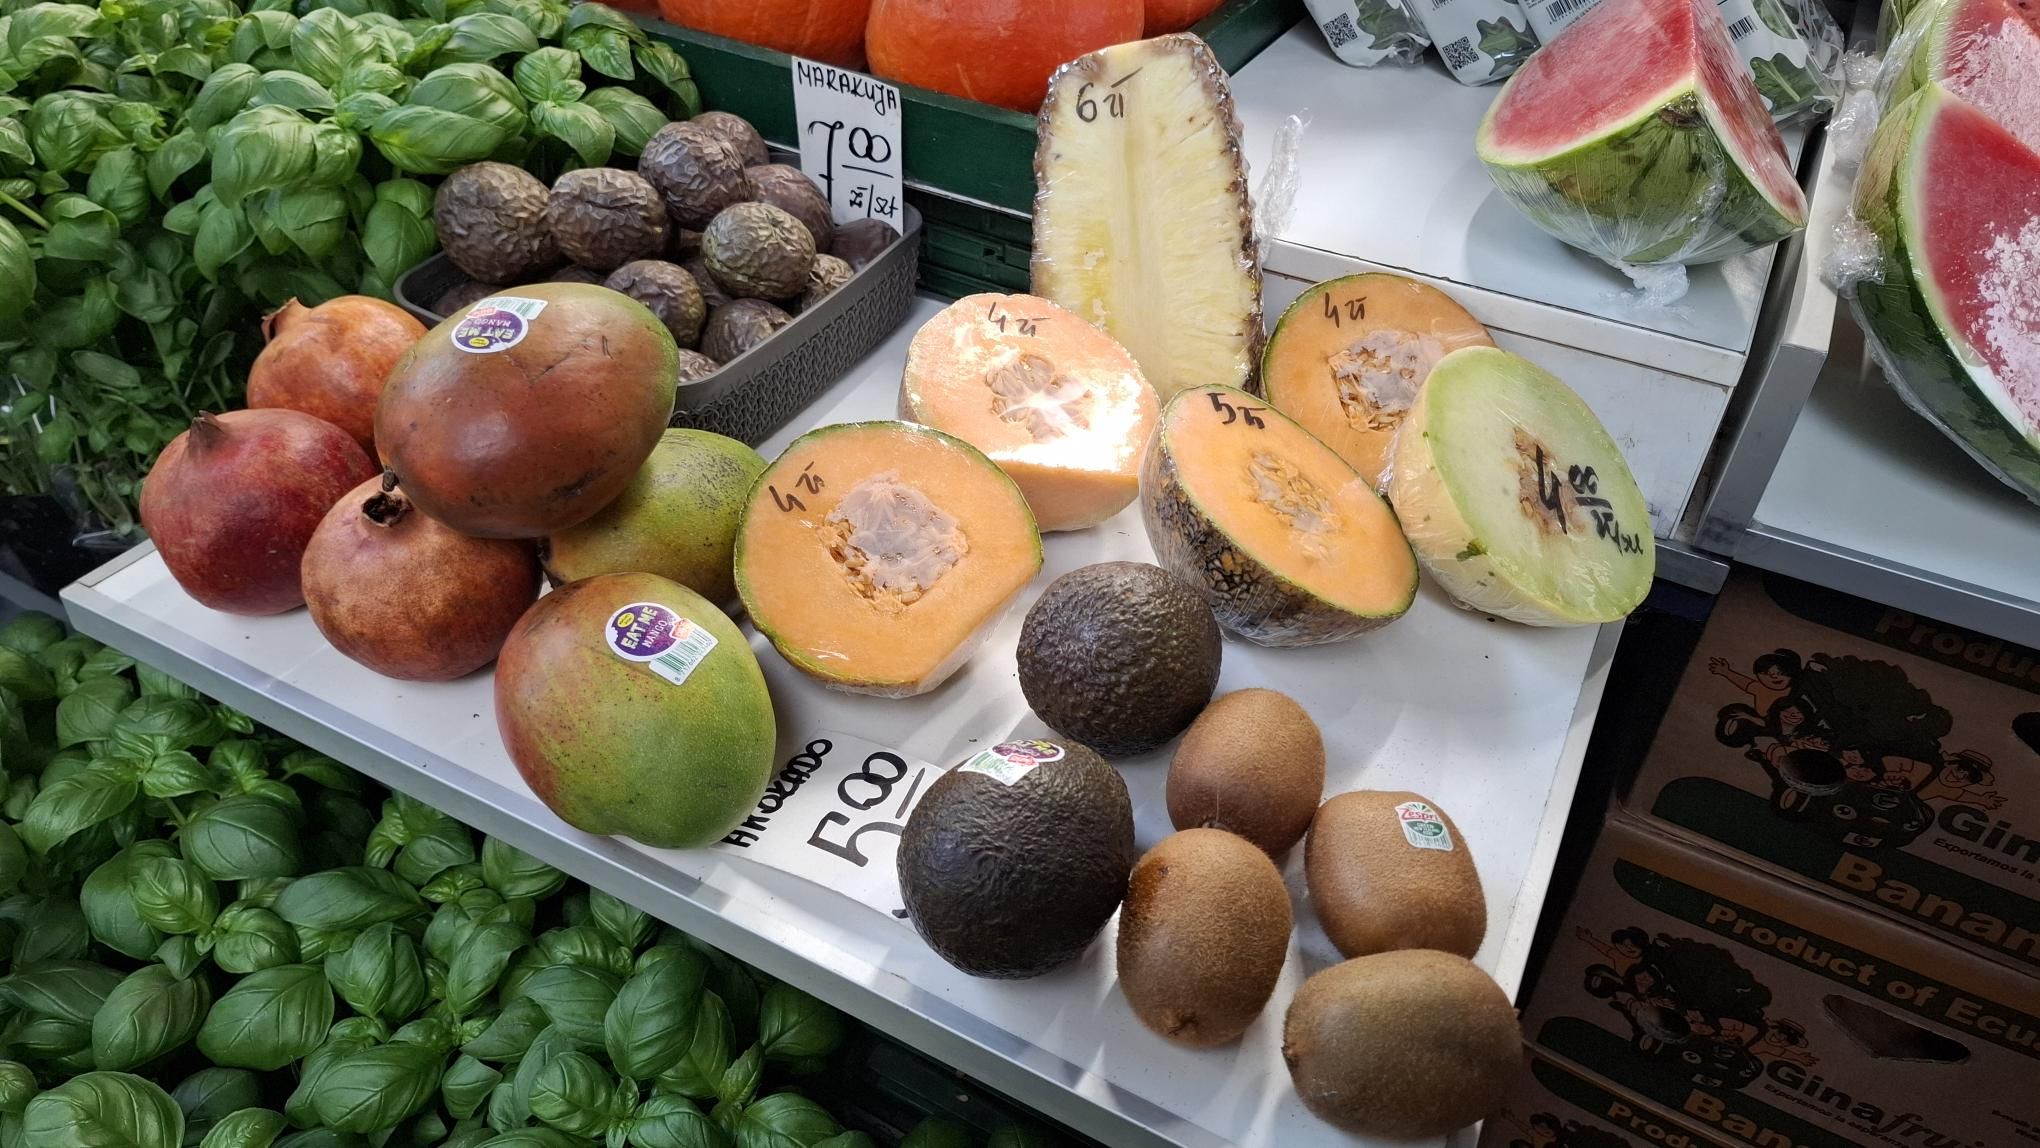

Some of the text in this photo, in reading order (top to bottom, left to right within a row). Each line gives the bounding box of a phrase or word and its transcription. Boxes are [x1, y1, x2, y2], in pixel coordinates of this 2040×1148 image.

[797, 61, 897, 116] MARAKUJA
[1076, 82, 1098, 123] 6
[987, 302, 1007, 333] 4
[1324, 292, 1340, 329] 4
[481, 327, 516, 340] EAT
[1207, 392, 1237, 425] 5
[768, 485, 807, 513] 4
[620, 622, 647, 650] EAT
[637, 606, 658, 626] ME
[641, 619, 668, 649] MANGO
[1933, 838, 2019, 873] Exportamos
[1705, 903, 1879, 985] Product
[1886, 980, 1939, 1008] of
